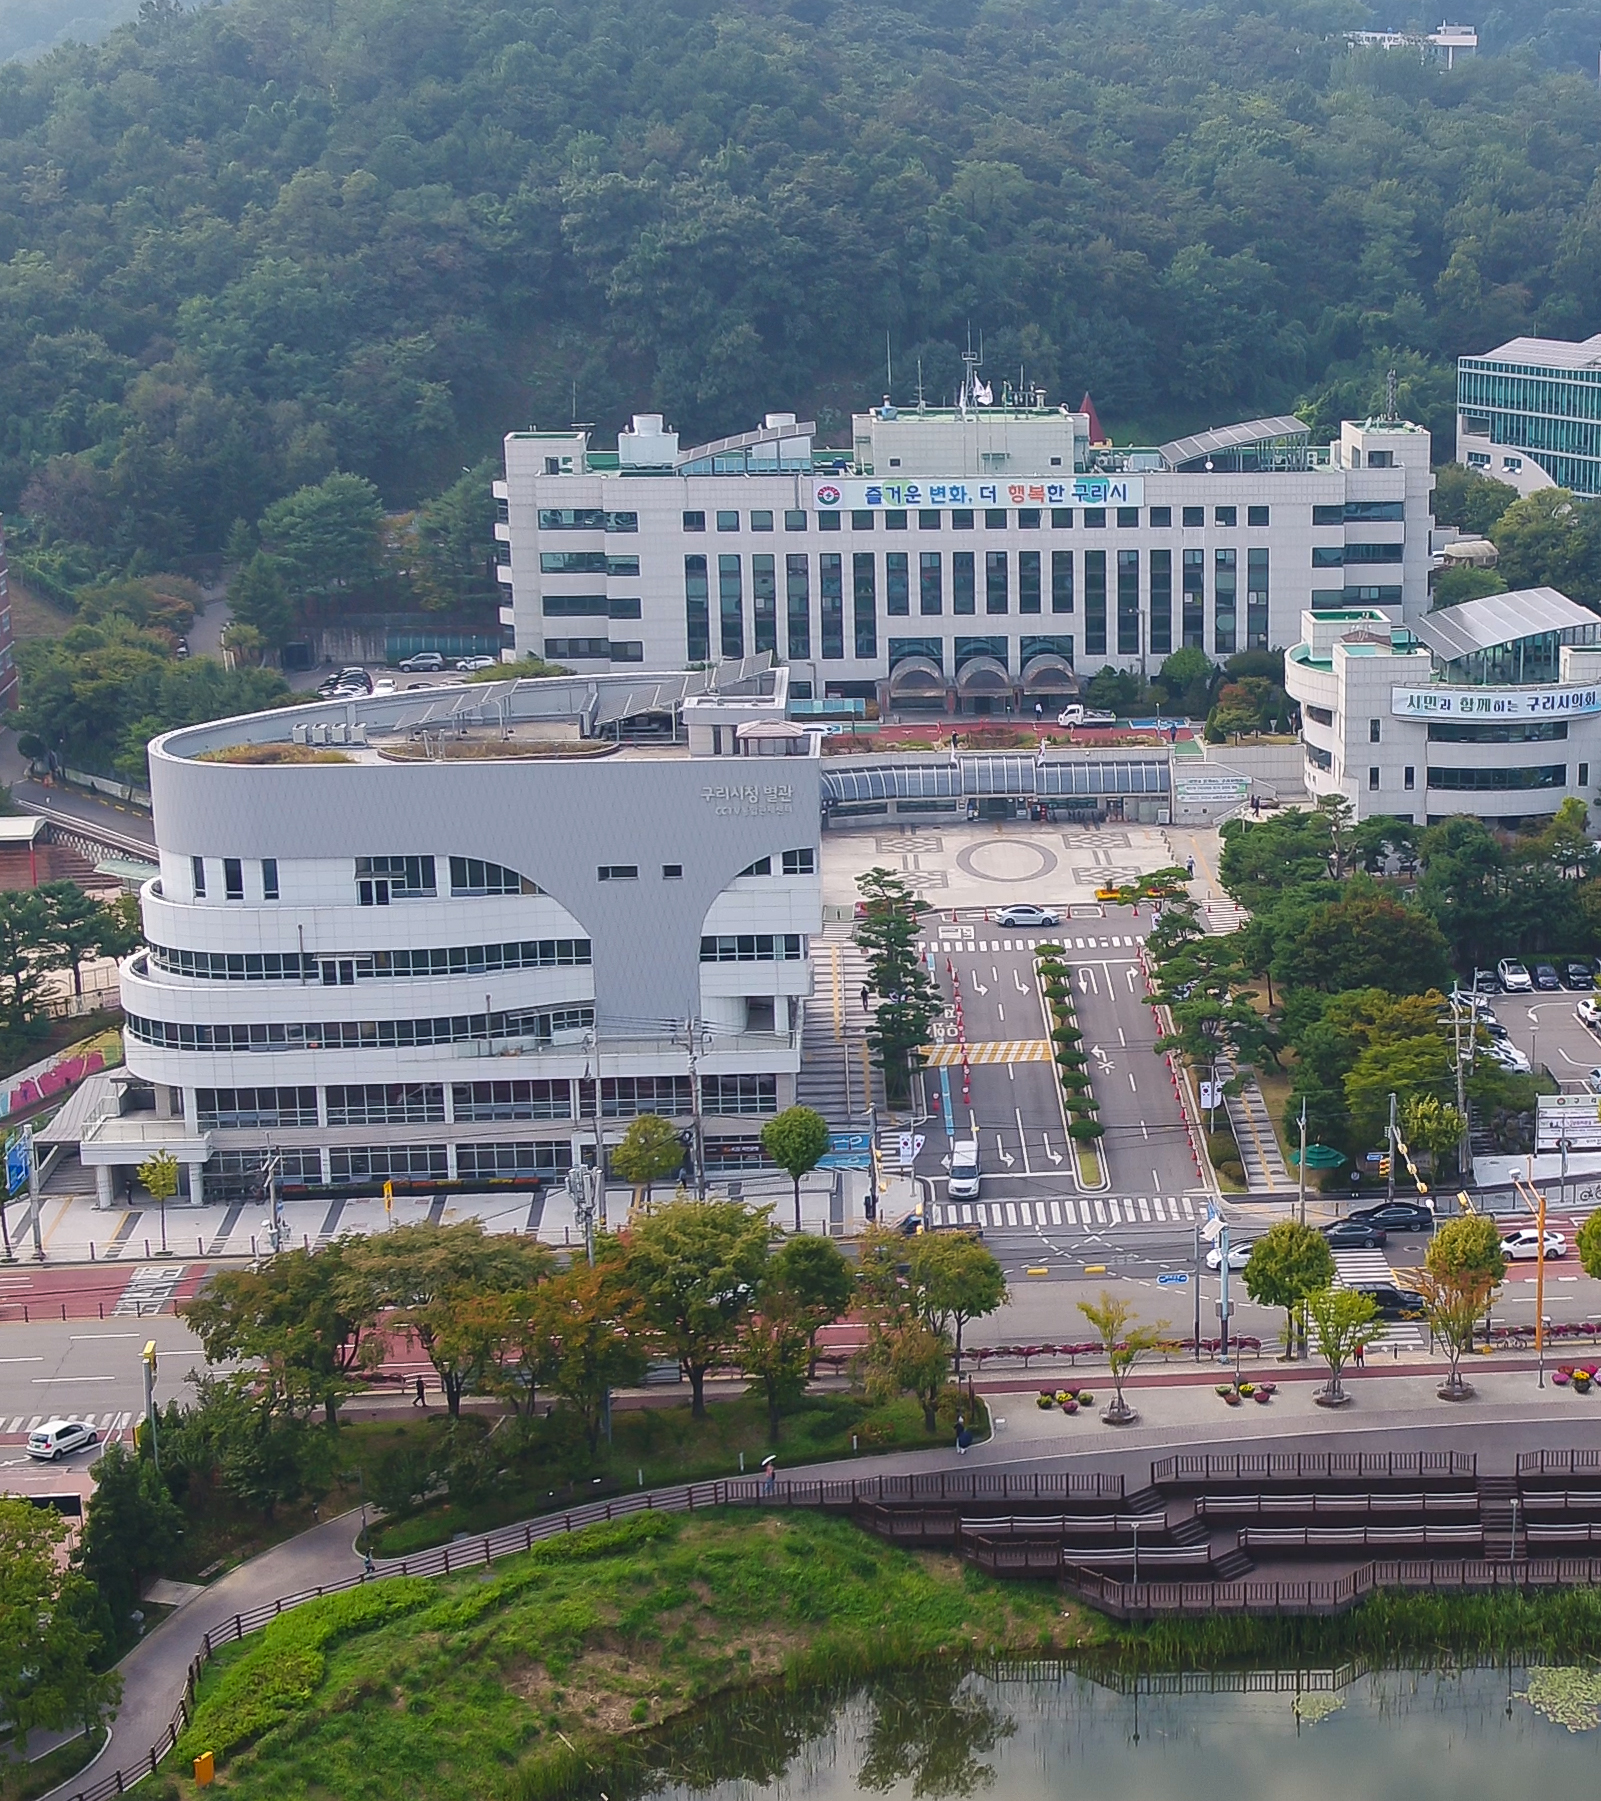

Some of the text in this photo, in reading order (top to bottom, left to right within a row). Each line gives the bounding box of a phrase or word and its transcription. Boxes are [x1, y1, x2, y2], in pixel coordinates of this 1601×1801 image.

[864, 485, 922, 504] 즐거운
[929, 484, 972, 504] 변화,
[980, 484, 997, 503] 더
[1007, 484, 1065, 503] 행복한
[1071, 482, 1127, 503] 구리시
[1406, 691, 1596, 712] 시민과 함께하는 구리시의회
[763, 785, 793, 803] 별관
